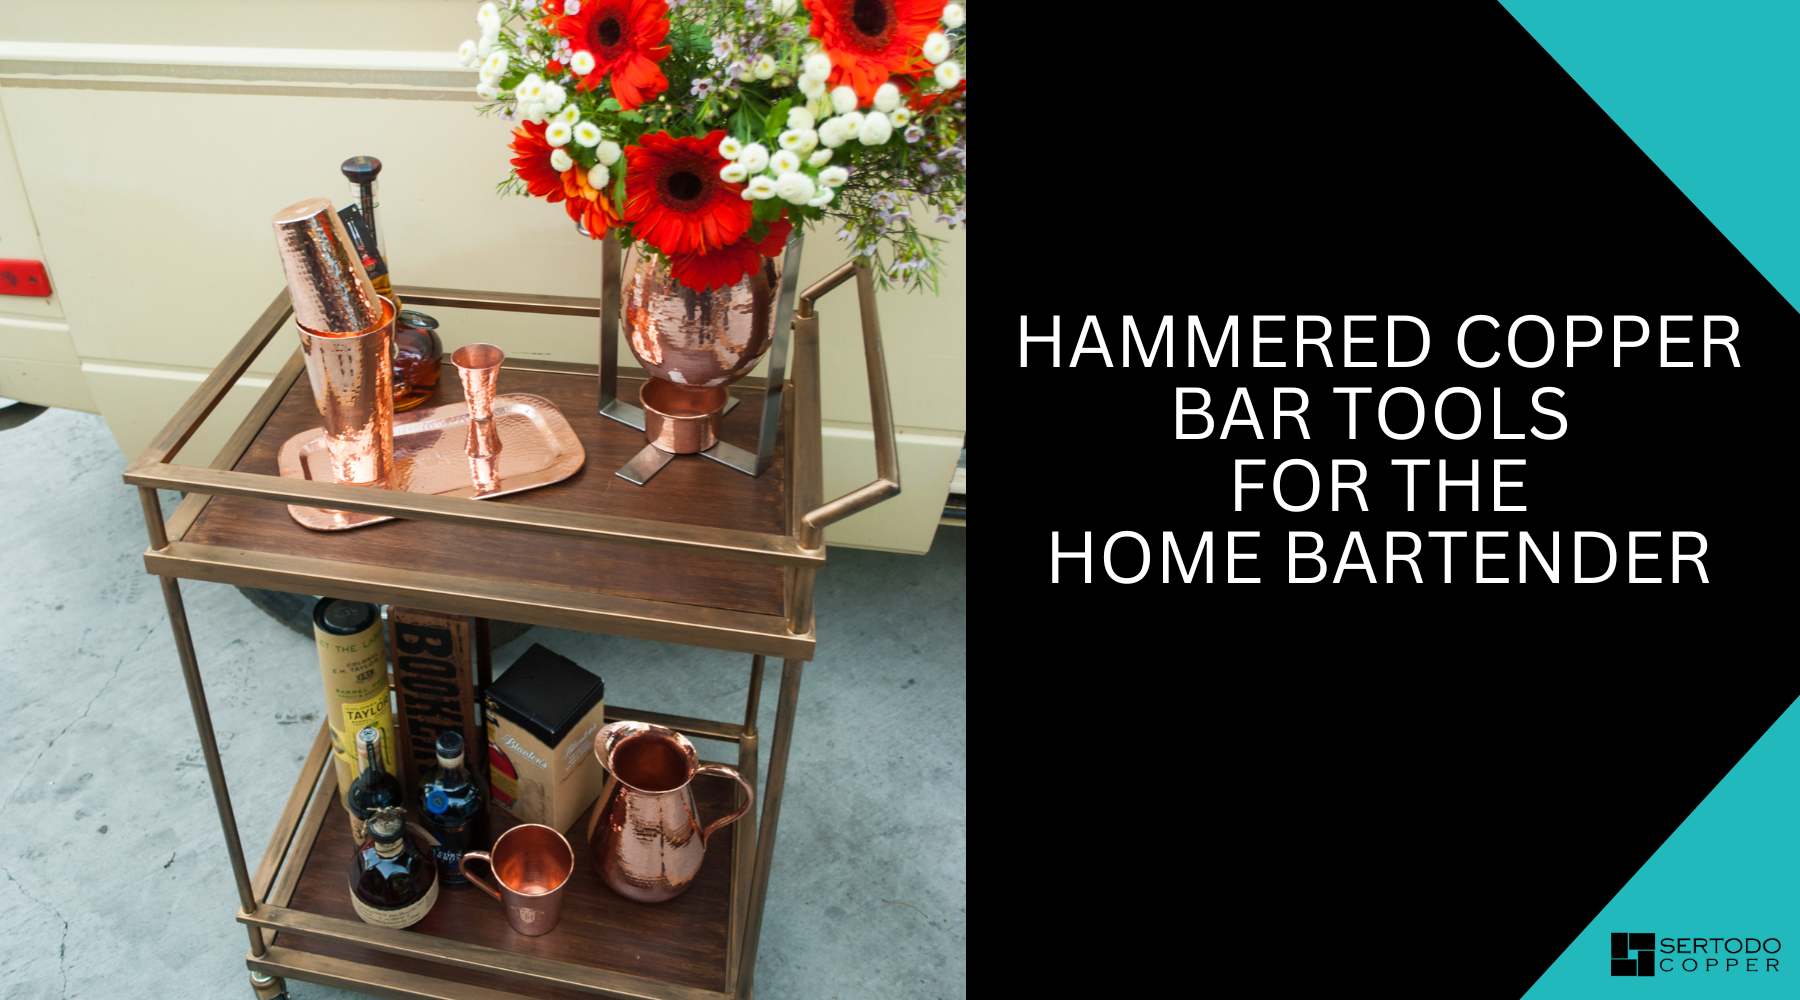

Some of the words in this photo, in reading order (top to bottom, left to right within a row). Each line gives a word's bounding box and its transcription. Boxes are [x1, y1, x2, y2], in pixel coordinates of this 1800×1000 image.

[319, 639, 330, 650] ET
[335, 644, 358, 653] THE
[363, 632, 382, 649] LAB
[346, 695, 389, 720] TAYLOR
[501, 734, 548, 769] Blanton's
